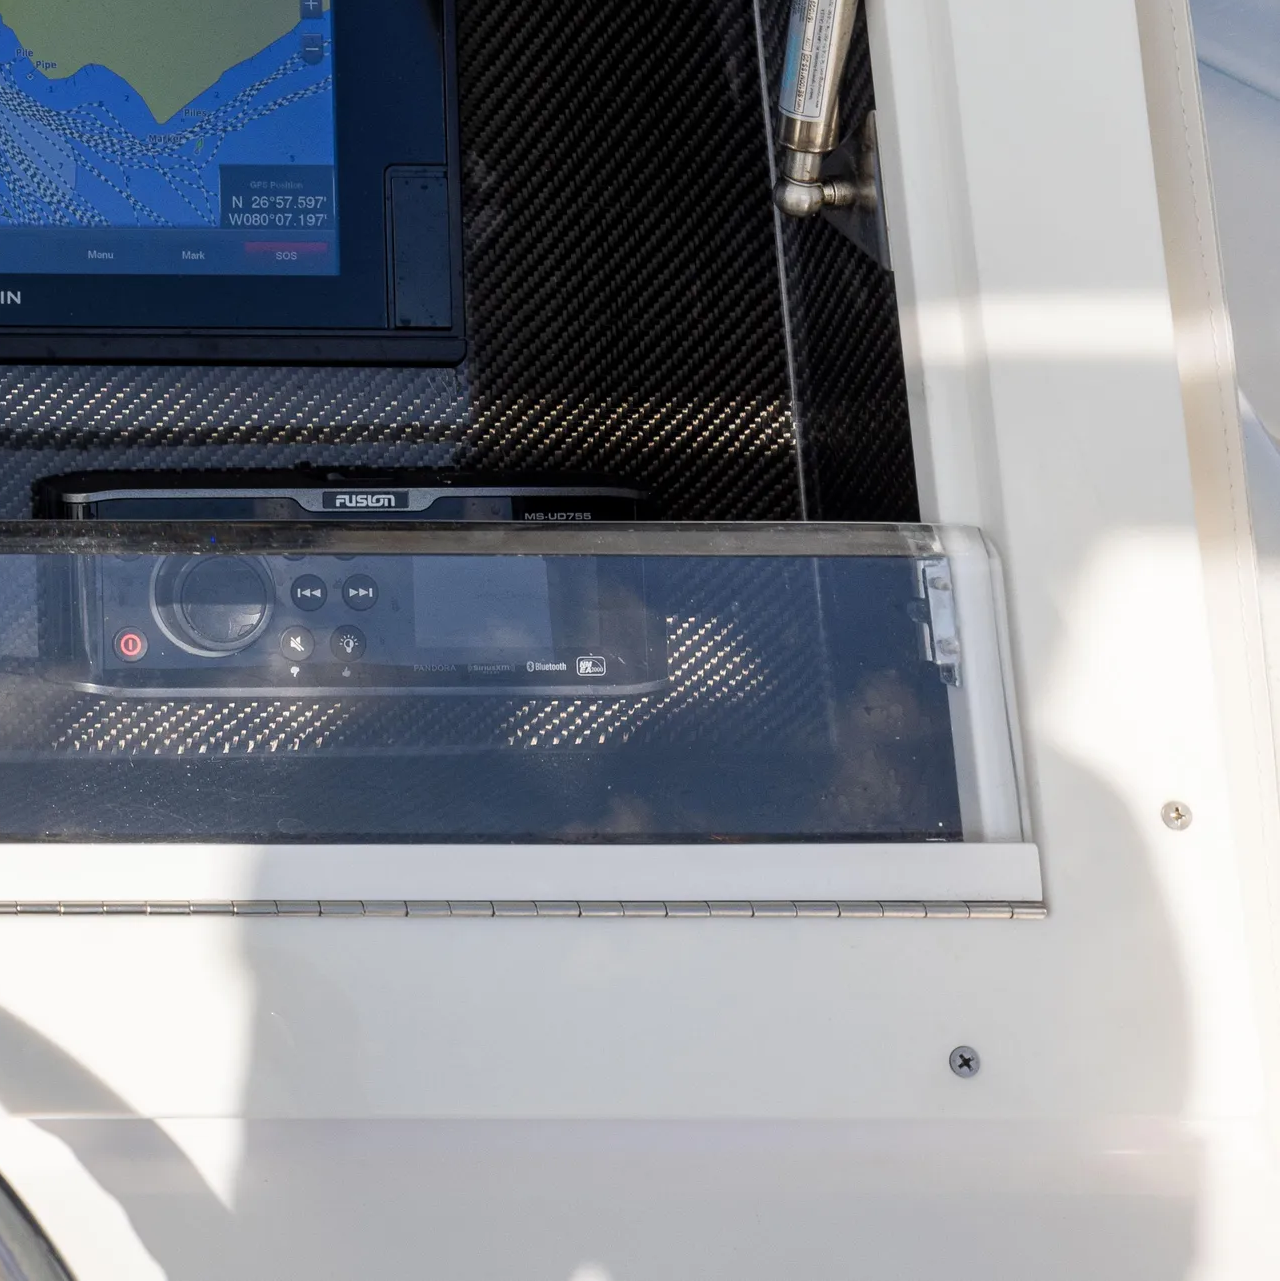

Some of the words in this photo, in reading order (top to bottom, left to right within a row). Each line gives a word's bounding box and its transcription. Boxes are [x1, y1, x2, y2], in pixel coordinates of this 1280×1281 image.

[15, 49, 34, 58] Pile
[35, 60, 57, 70] Pipe
[184, 108, 207, 118] Piles
[148, 134, 184, 144] Marker
[231, 195, 243, 209] N
[87, 250, 114, 260] Menu
[182, 251, 206, 260] Mark
[275, 251, 298, 261] SOS
[335, 494, 396, 507] FUSION
[413, 664, 457, 672] PANDORA
[535, 662, 567, 671] Bluetooth
